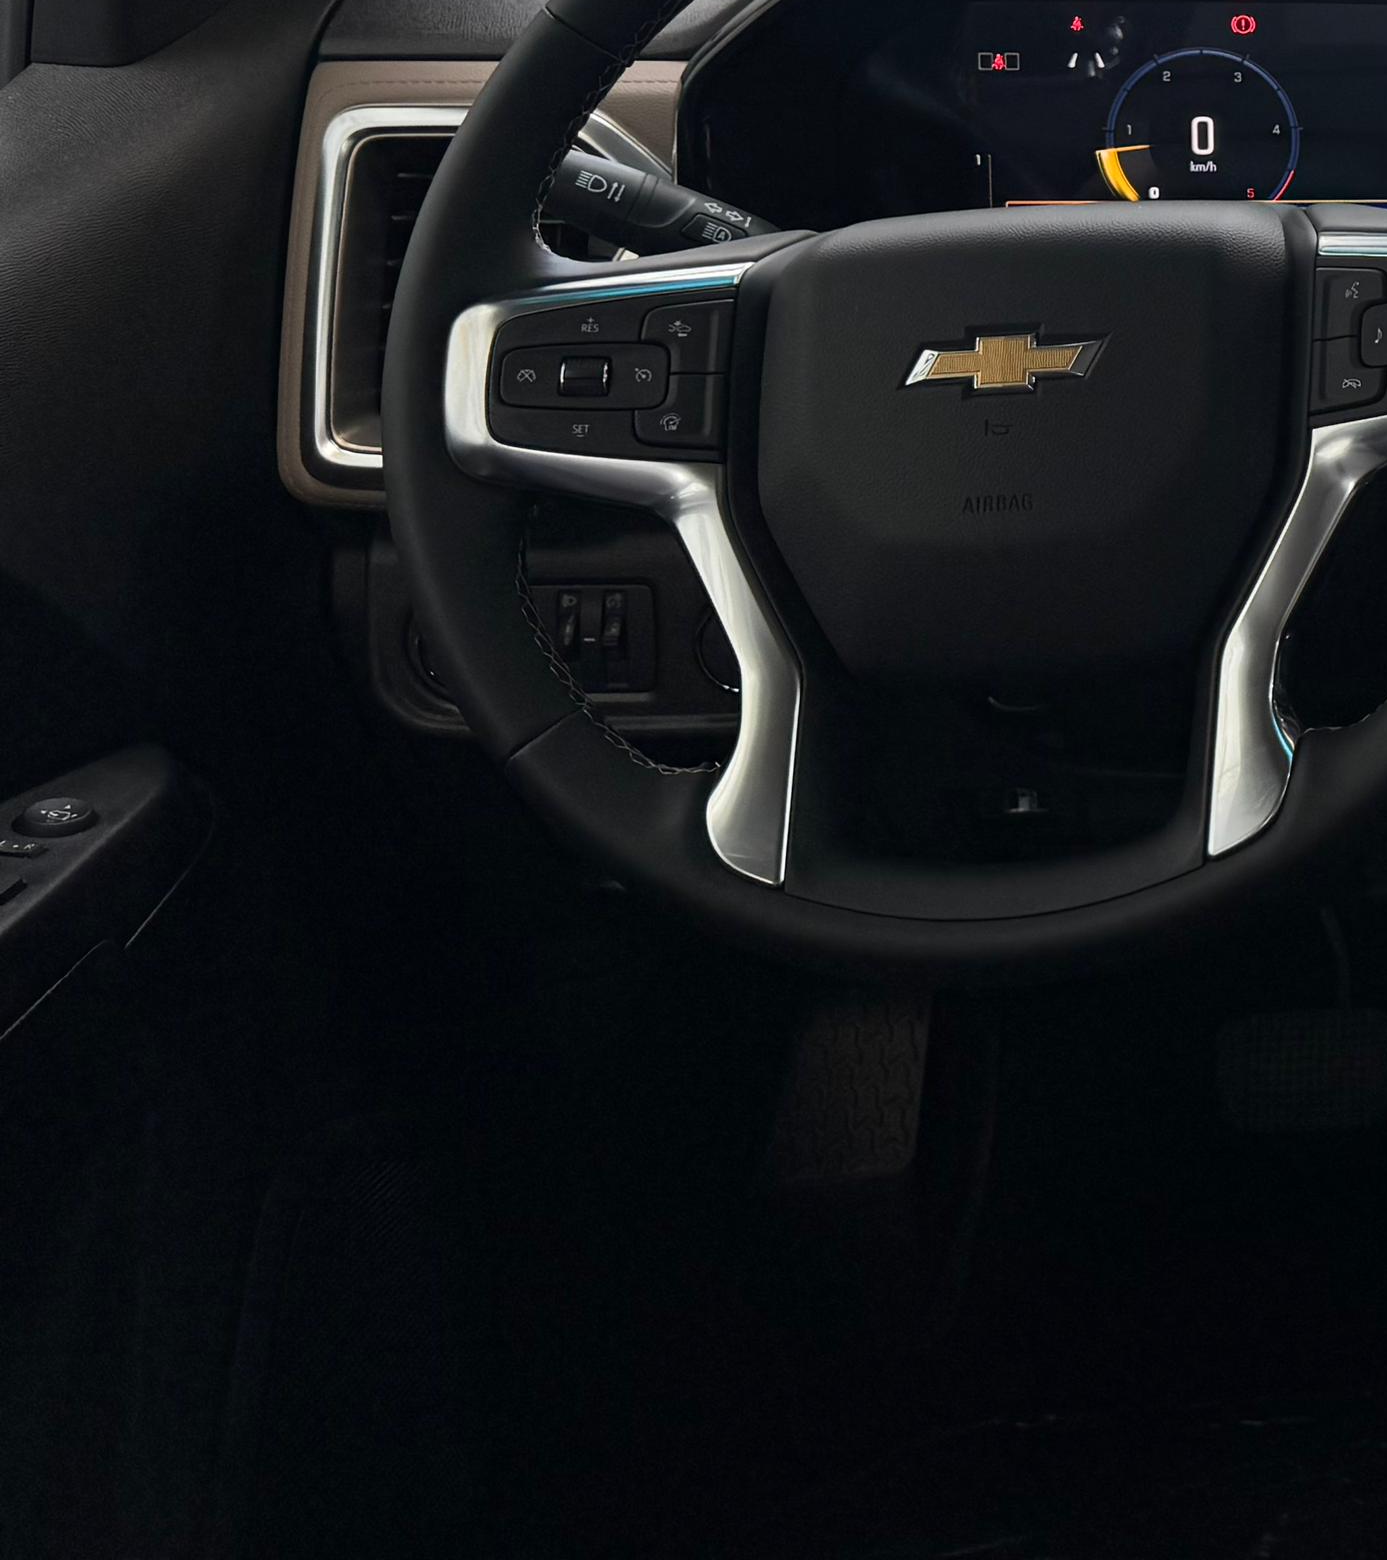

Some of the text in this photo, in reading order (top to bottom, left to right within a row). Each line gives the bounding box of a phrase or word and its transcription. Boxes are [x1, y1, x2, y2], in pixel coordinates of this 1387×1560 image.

[1163, 72, 1171, 82] 2
[1234, 72, 1242, 82] 3
[1127, 125, 1133, 135] 1
[1272, 124, 1281, 135] 4
[1191, 116, 1214, 155] 0
[1190, 160, 1217, 173] km/h
[1149, 187, 1160, 199] 0
[1247, 188, 1255, 199] 5
[581, 323, 599, 333] RES
[572, 424, 590, 434] SET
[962, 493, 1033, 514] AIRBAG
